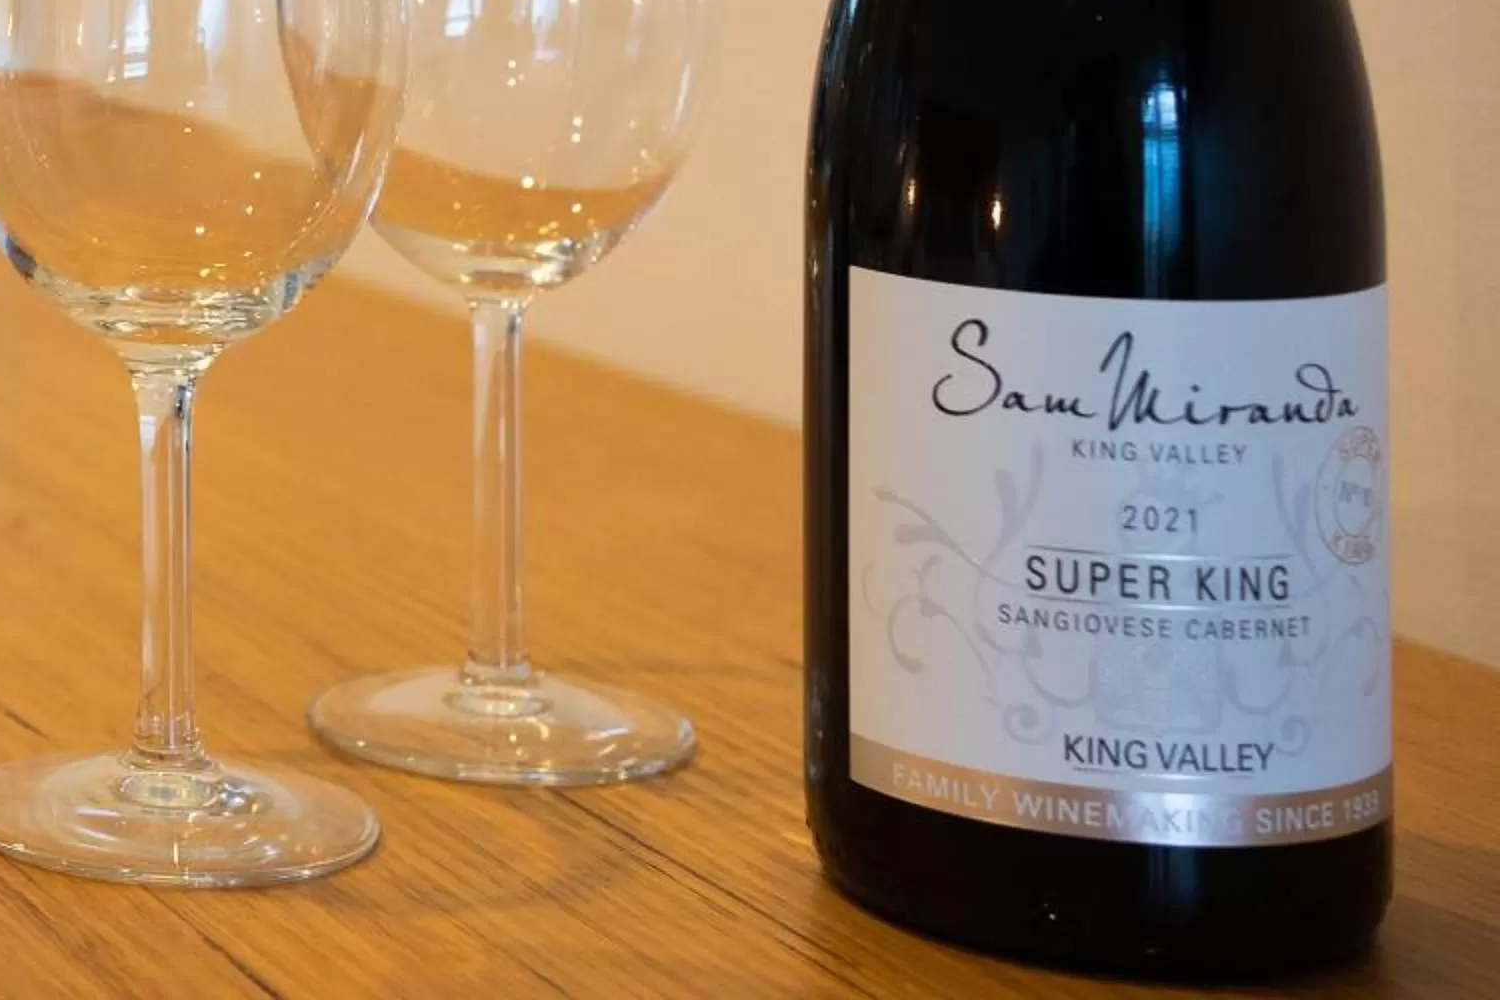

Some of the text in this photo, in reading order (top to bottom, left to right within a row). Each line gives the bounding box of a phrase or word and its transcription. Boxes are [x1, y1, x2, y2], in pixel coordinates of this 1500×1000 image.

[931, 319, 1359, 431] Sam Miranda
[1072, 439, 1248, 465] KING VALLEY
[1122, 505, 1198, 533] 2021
[1025, 555, 1290, 602] SUPER KING
[998, 604, 1311, 640] SANGIOVESE CABERNET
[1063, 734, 1275, 772] KING VALLEY
[892, 763, 999, 811] FAMILY
[1011, 790, 1242, 835] WINEMAKING
[1255, 801, 1334, 834] SINCE
